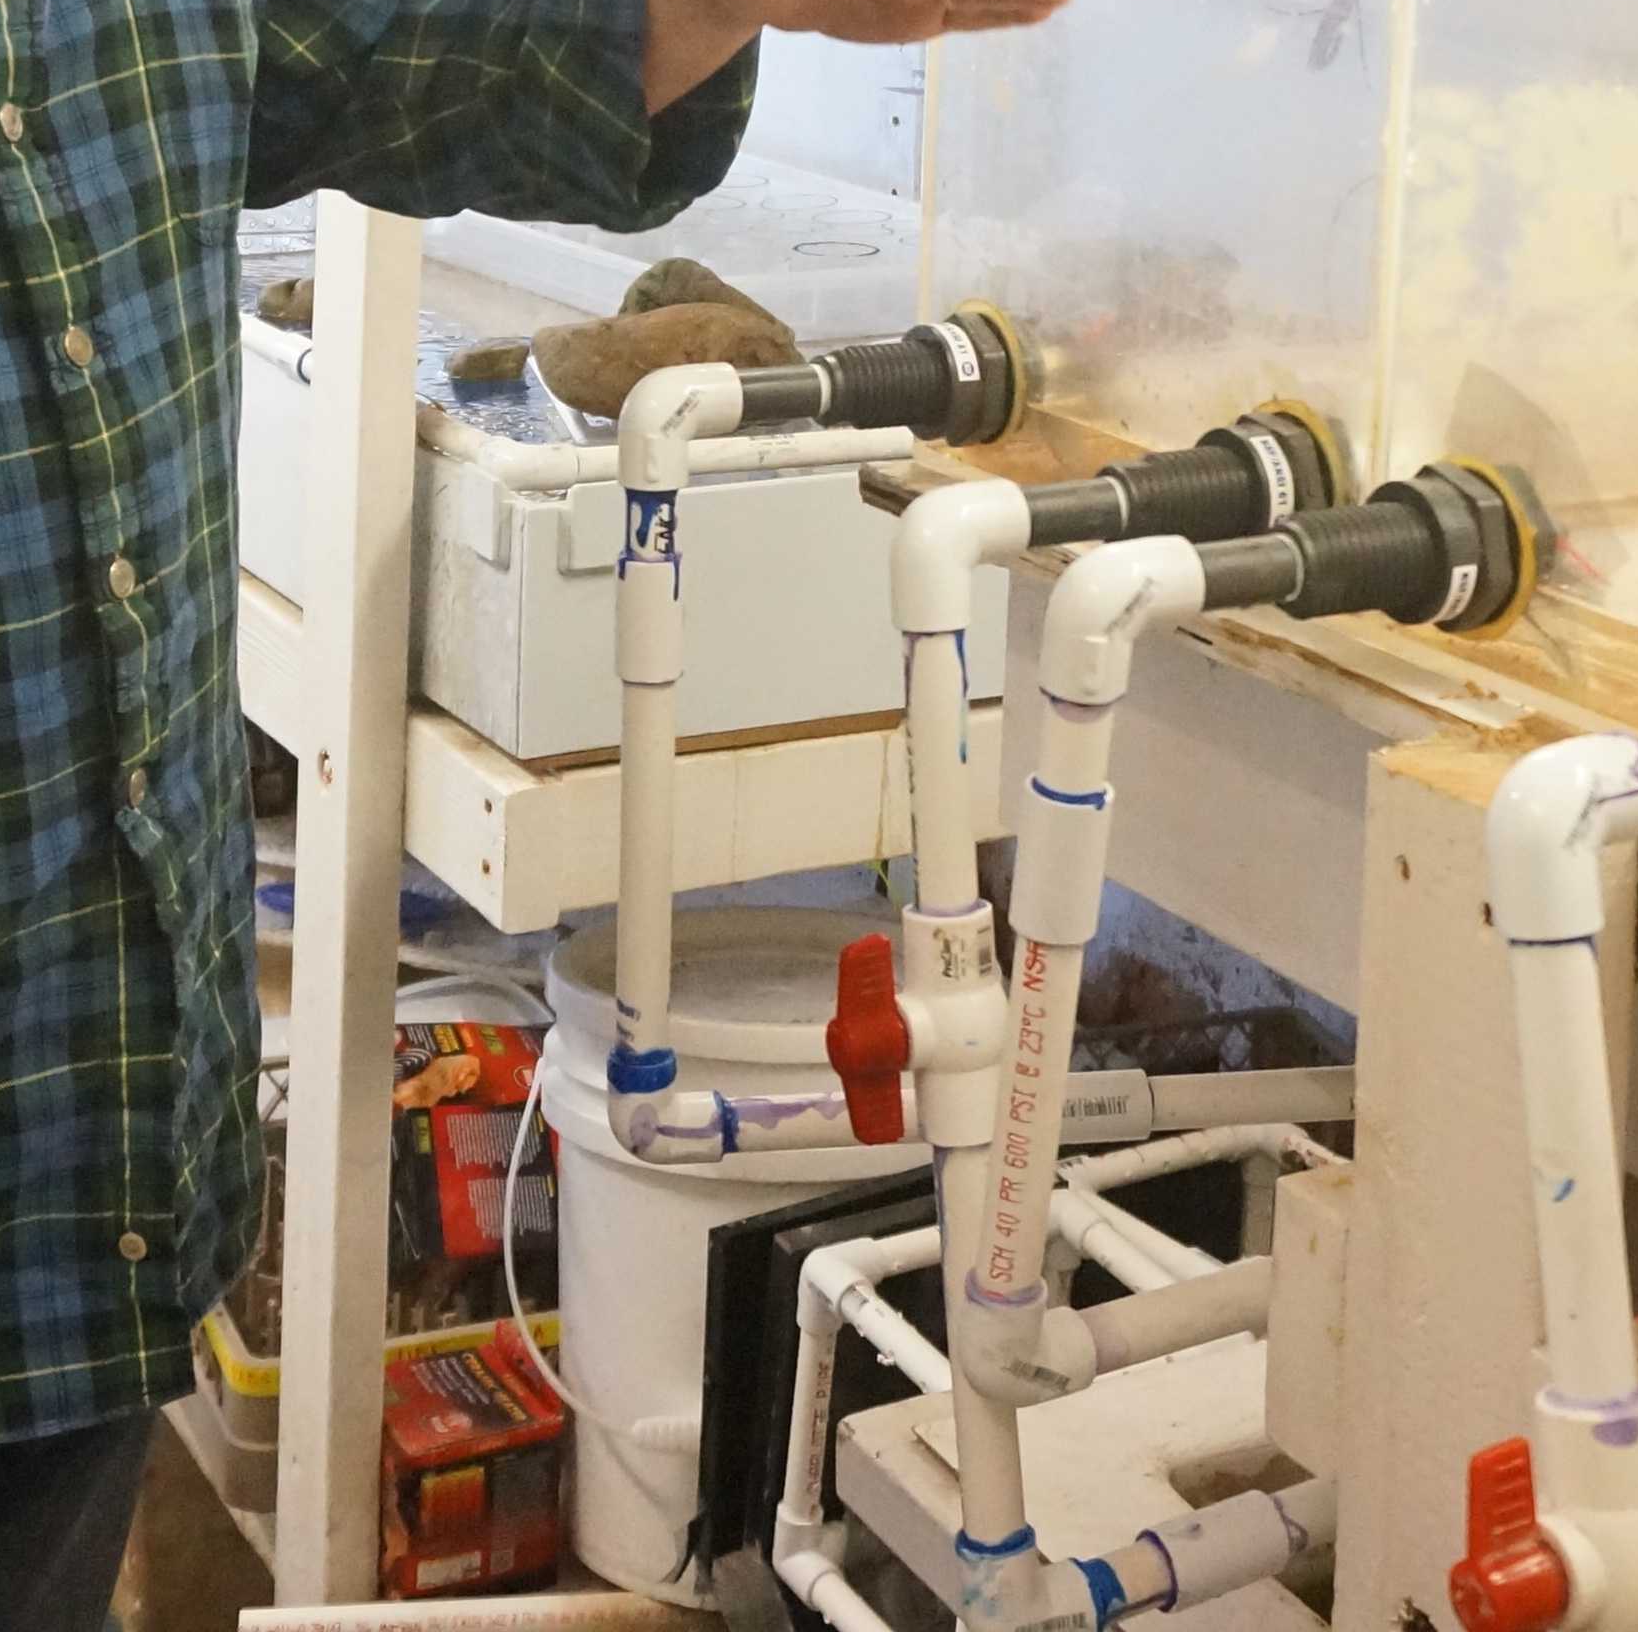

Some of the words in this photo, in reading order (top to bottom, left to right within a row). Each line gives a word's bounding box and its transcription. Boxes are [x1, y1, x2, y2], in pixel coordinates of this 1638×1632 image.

[1009, 1084, 1039, 1125] PSI
[1003, 1131, 1031, 1170] 600
[999, 1175, 1027, 1205] PR
[994, 1210, 1022, 1238] 40
[989, 1244, 1016, 1283] SCH
